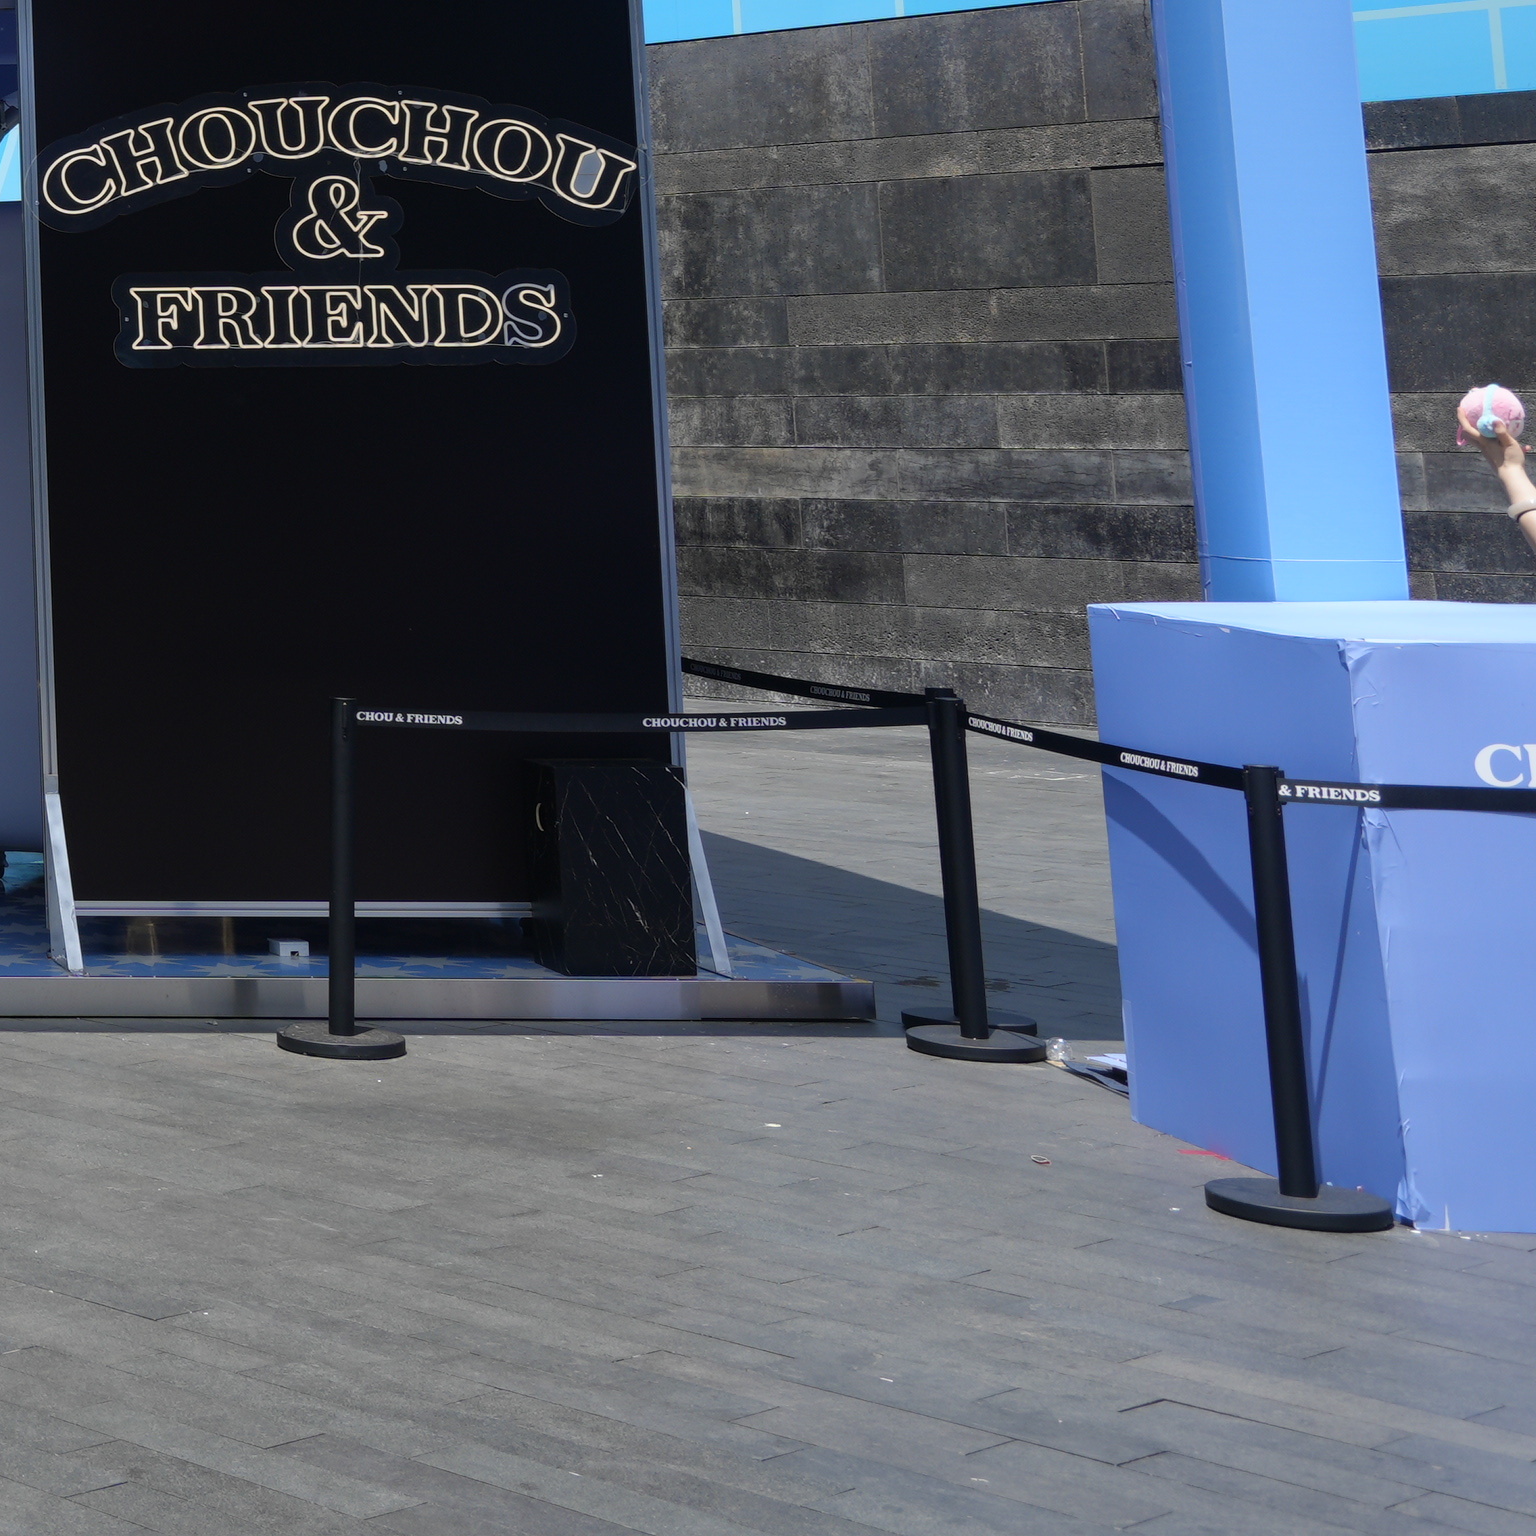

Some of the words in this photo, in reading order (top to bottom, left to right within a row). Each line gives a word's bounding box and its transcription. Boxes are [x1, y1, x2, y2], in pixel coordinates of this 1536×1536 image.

[42, 96, 636, 216] CHOUCHOU
[293, 175, 388, 259] &
[130, 282, 562, 351] FRIENDS
[356, 711, 394, 722] CHOU
[395, 713, 405, 723] &
[406, 713, 463, 725] FRIENDS
[642, 717, 717, 728] CHOUCHOU
[718, 717, 728, 727] &
[729, 716, 787, 727] FRIENDS
[968, 716, 1002, 734] CHOUCHOU
[1001, 725, 1006, 735] &
[1006, 726, 1034, 742] FRIENDS
[1120, 752, 1161, 770] CHOUCHOU
[1160, 760, 1166, 771] &
[1166, 761, 1199, 777] FRIENDS
[1278, 784, 1292, 797] &
[1294, 784, 1381, 802] FRIENDS
